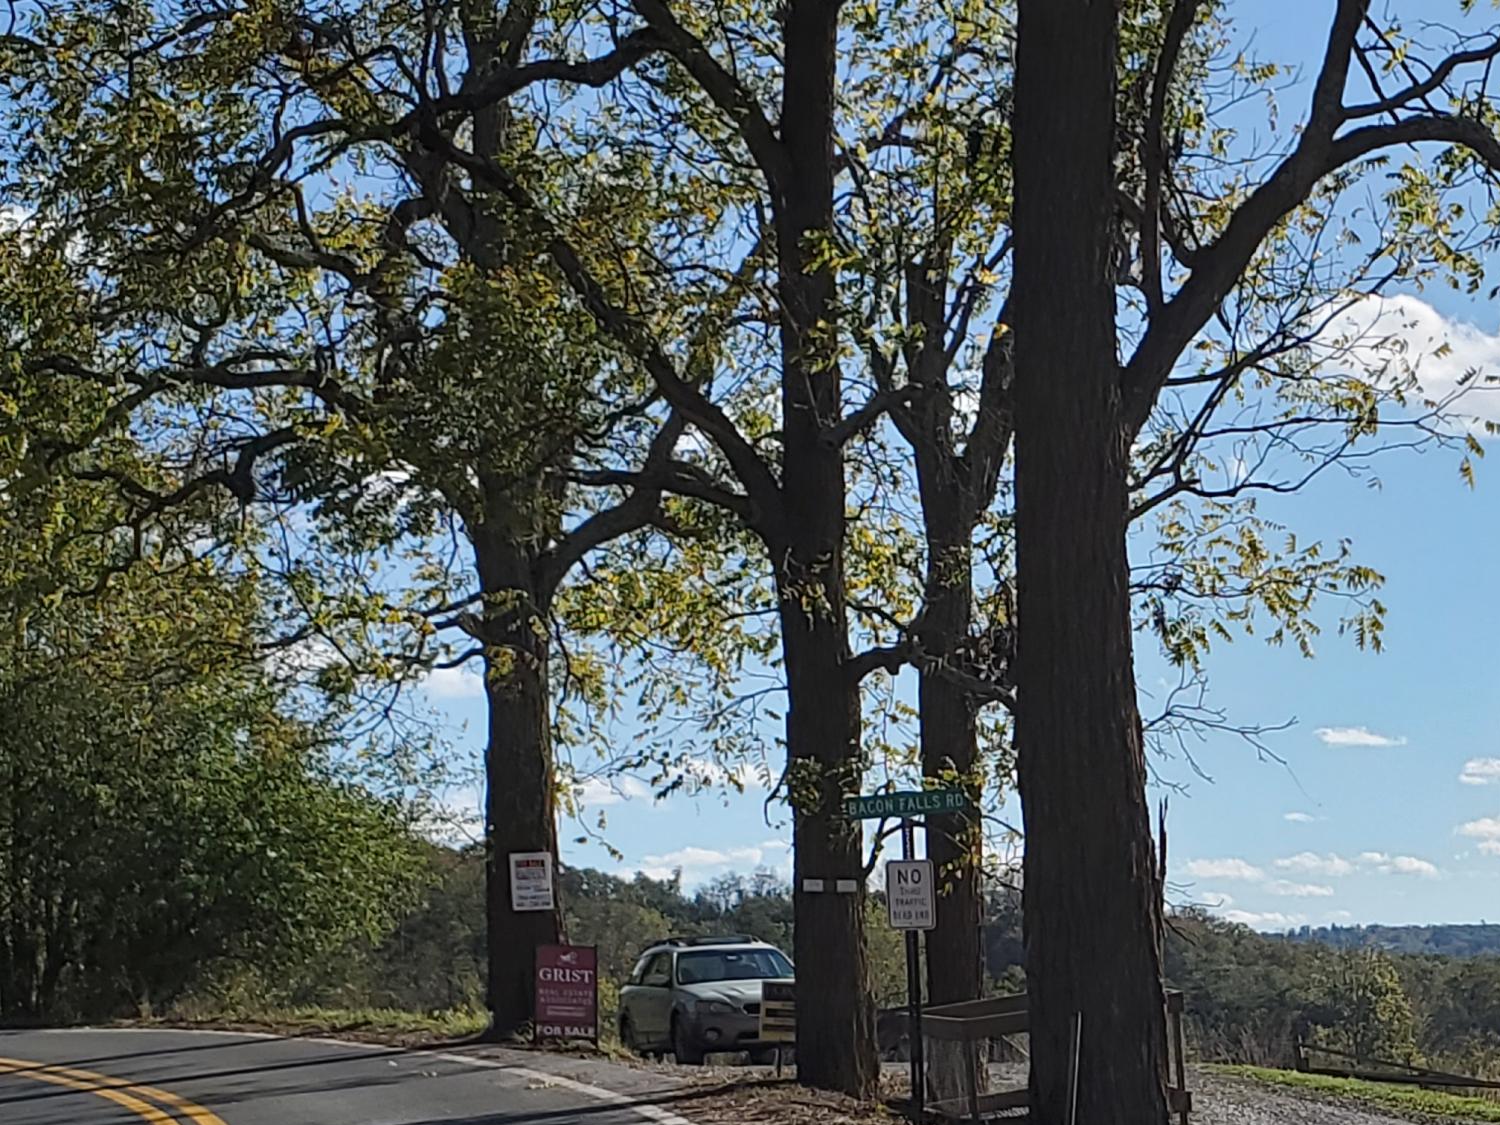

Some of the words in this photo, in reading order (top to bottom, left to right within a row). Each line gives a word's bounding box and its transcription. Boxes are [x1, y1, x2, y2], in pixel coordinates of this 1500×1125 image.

[849, 799, 893, 815] BACON
[899, 795, 940, 810] FALLS
[946, 793, 963, 807] RD
[897, 869, 921, 884] NO
[539, 967, 593, 983] GRIST
[536, 1025, 562, 1035] FOR
[564, 1026, 595, 1037] SALE
